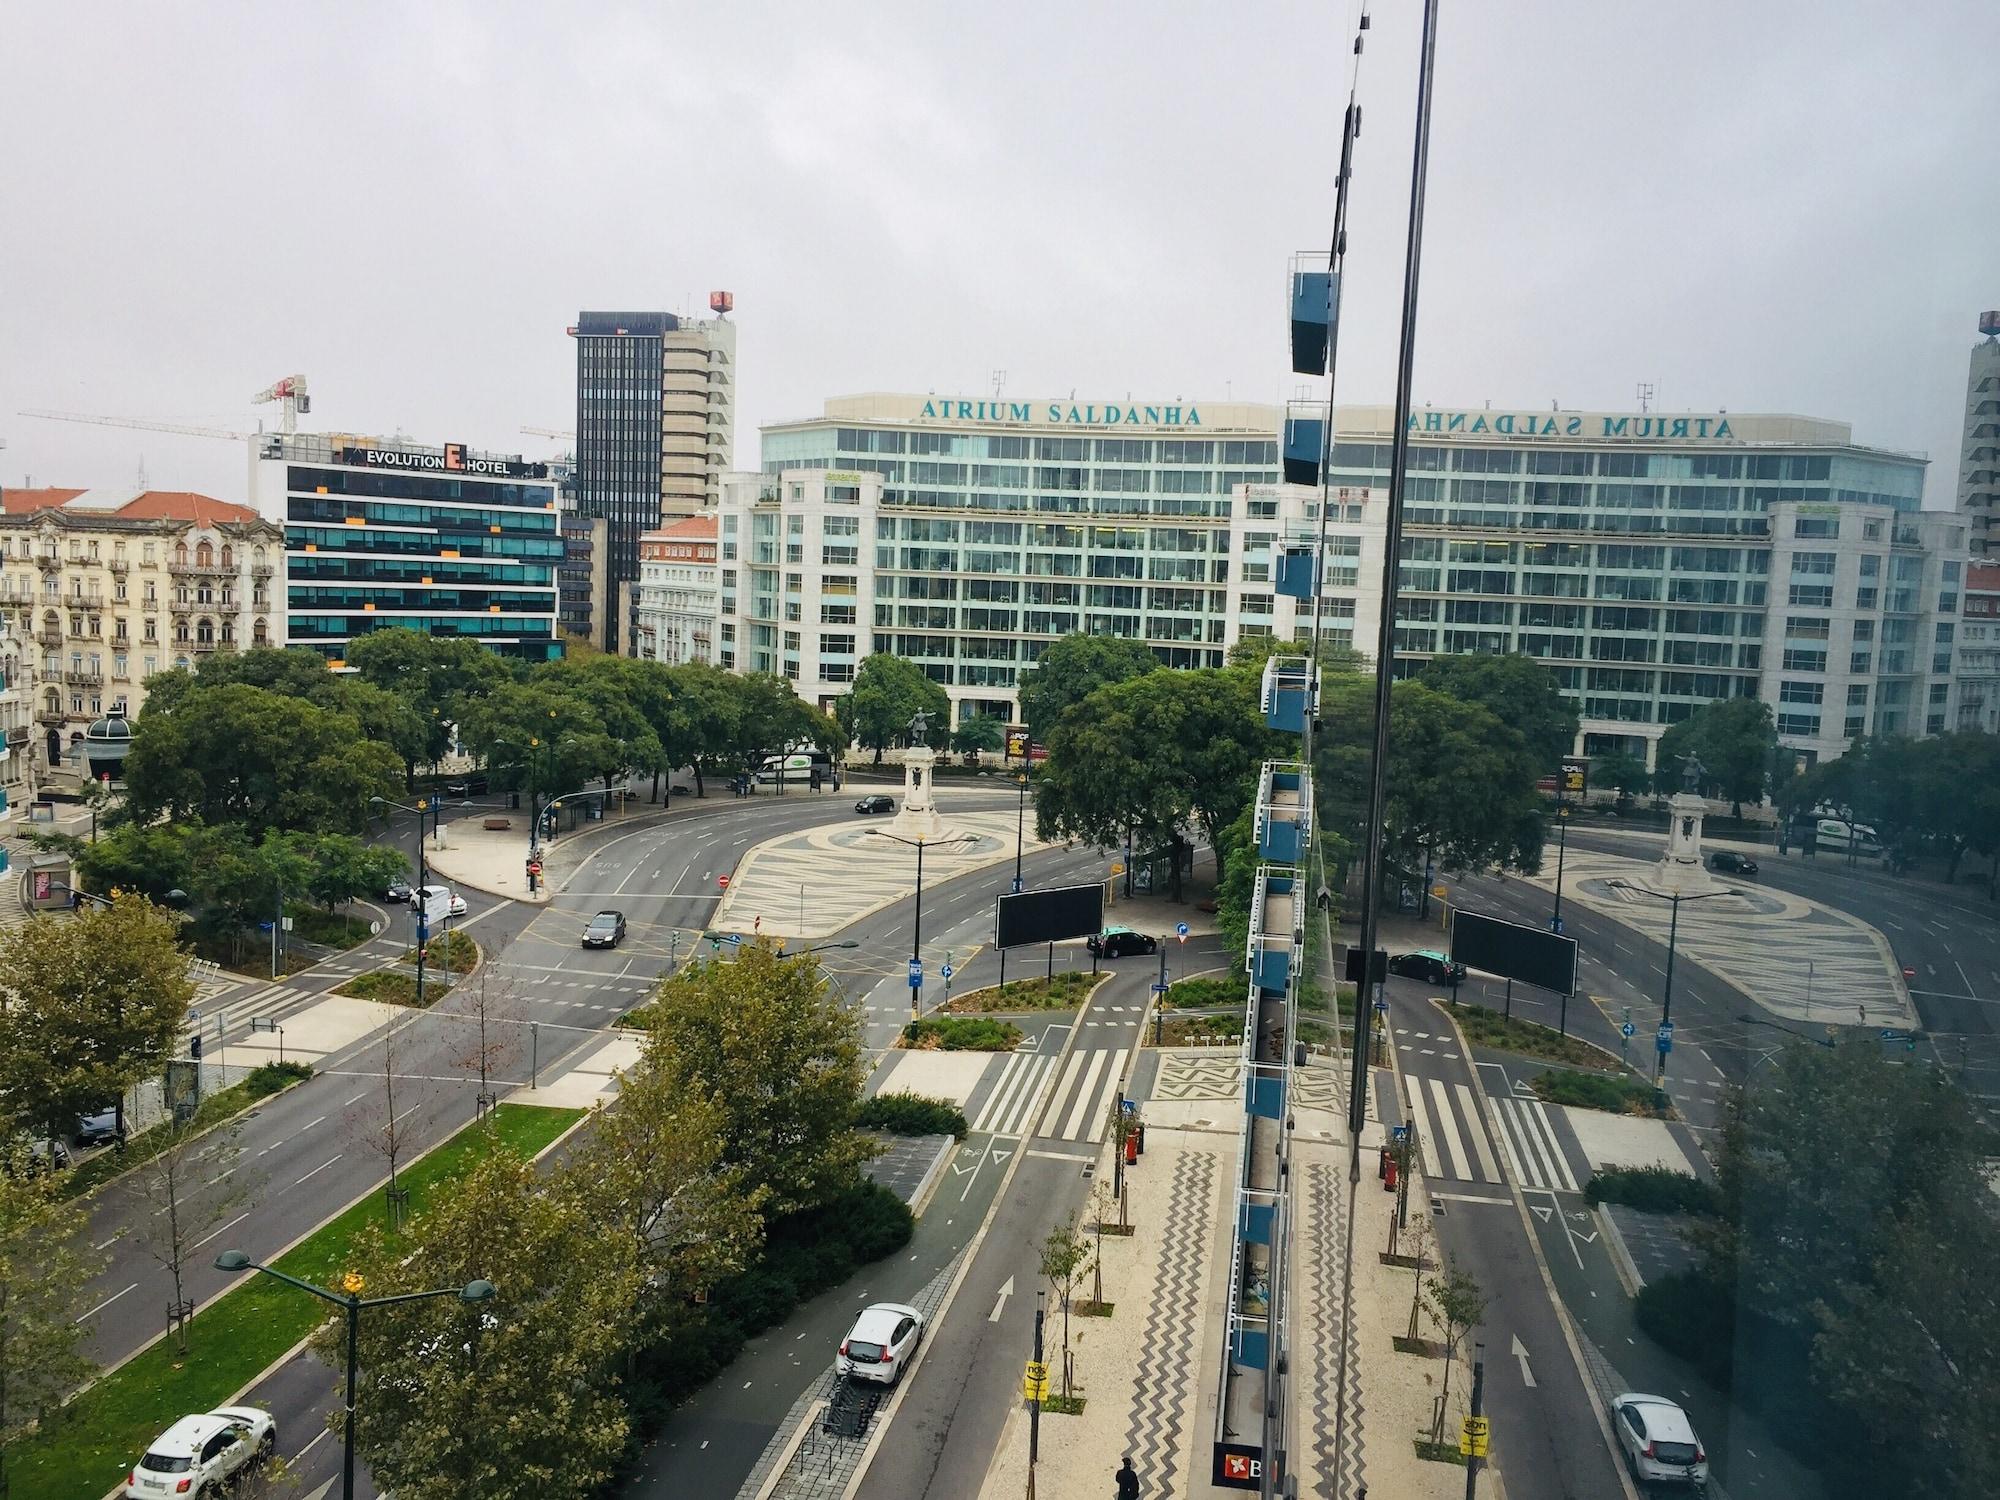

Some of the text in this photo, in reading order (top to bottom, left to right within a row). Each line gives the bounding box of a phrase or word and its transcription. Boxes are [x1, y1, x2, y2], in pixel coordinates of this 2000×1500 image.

[920, 400, 1201, 425] ATRIUM SALDANHA
[367, 450, 445, 469] EVOLUTION
[467, 460, 511, 474] HOTEL
